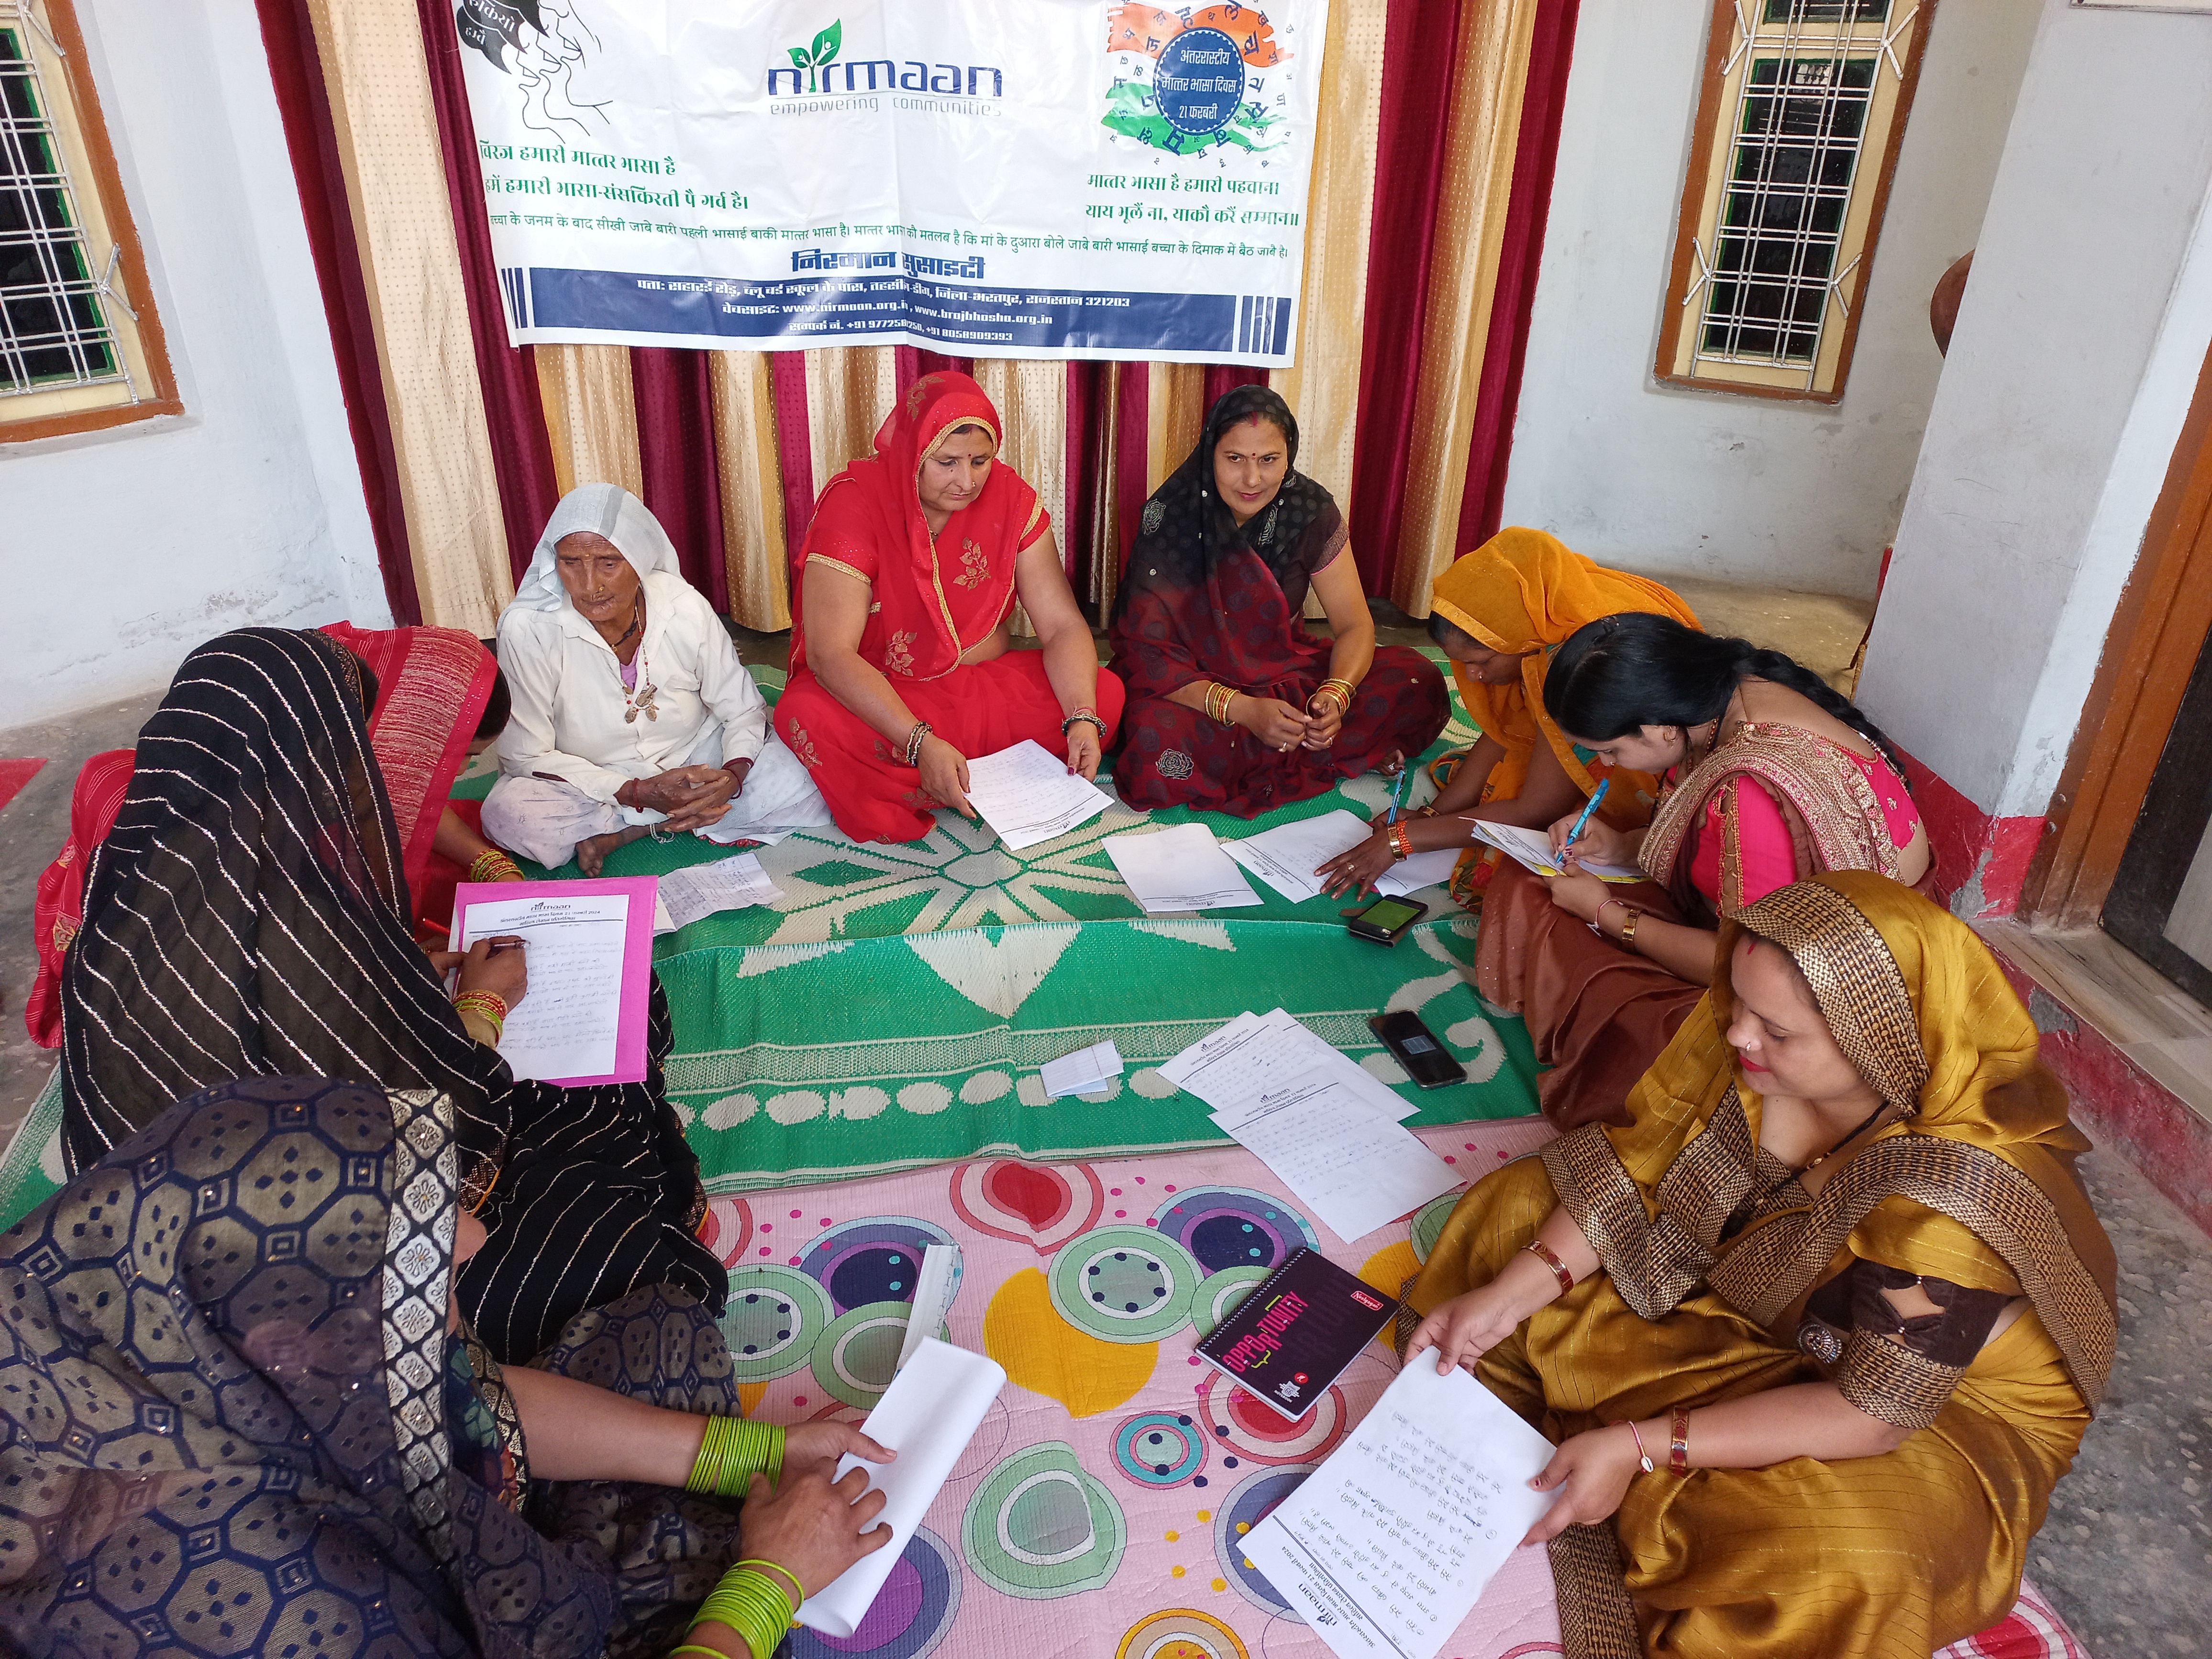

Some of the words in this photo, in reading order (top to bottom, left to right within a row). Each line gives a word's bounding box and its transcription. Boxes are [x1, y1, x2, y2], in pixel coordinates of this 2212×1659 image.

[768, 48, 1002, 97] nirmaan
[1191, 78, 1214, 92] भासा
[1215, 76, 1238, 93] दिवस
[771, 96, 879, 116] empowering
[893, 97, 1002, 117] communities
[1179, 105, 1187, 118] 21
[518, 145, 565, 163] हमारी
[571, 150, 617, 169] मात्तर
[621, 156, 660, 174] भासा
[664, 156, 675, 175] है
[485, 174, 500, 193] हमें
[504, 176, 552, 195] हमारी
[684, 188, 697, 207] पै
[700, 191, 727, 209] गर्व
[731, 191, 748, 209] है।
[1087, 174, 1127, 189] मात्तर
[1131, 176, 1167, 190] भासा
[1171, 173, 1180, 191] है
[1184, 176, 1223, 192] हमारी
[1086, 205, 1114, 219] याय
[1118, 202, 1143, 224] भूलैं
[1148, 207, 1168, 223] ना,
[1172, 204, 1211, 222] याकौ
[1214, 206, 1236, 223] करैं
[509, 211, 520, 225] के
[524, 215, 553, 227] जनम
[556, 213, 568, 227] के
[572, 218, 593, 230] बाद
[596, 216, 625, 231] सीखी
[629, 220, 652, 232] जाबे
[655, 222, 676, 234] बारी
[679, 225, 708, 239] पहली
[712, 226, 748, 240] भासाई
[750, 227, 777, 240] बाकी
[812, 226, 837, 238] भासा
[840, 222, 850, 238] है।
[907, 224, 917, 239] कौ
[920, 230, 951, 243] मतलब
[953, 229, 961, 246] है
[963, 231, 977, 245] कि
[980, 233, 994, 246] मां
[996, 232, 1007, 247] के
[1010, 237, 1041, 253] दुआरा
[1043, 234, 1065, 249] बोले
[1068, 236, 1090, 251] जाबे
[1093, 238, 1113, 252] बारी
[1117, 239, 1149, 254] भासाई
[1151, 243, 1176, 254] बच्चा
[1178, 240, 1189, 254] के
[1192, 241, 1224, 255] दिमाक
[1227, 243, 1237, 256] में
[1239, 242, 1254, 256] बैठ
[1257, 243, 1277, 257] जाबै
[1279, 244, 1288, 258] है।
[901, 252, 985, 279] सुसाइटी
[637, 279, 665, 291] पता:
[820, 280, 835, 292] के
[838, 282, 867, 293] पास,
[1085, 296, 1130, 307] 321203
[846, 320, 865, 329] +91
[926, 326, 940, 337] +91
[941, 328, 1013, 341] 8058909393
[1222, 1290, 1309, 1373] OPPORTUNITY
[1274, 1389, 1293, 1404] NOTEBOOK
[1282, 1546, 1294, 1559] 2024
[1299, 1583, 1338, 1626] nirmaan
